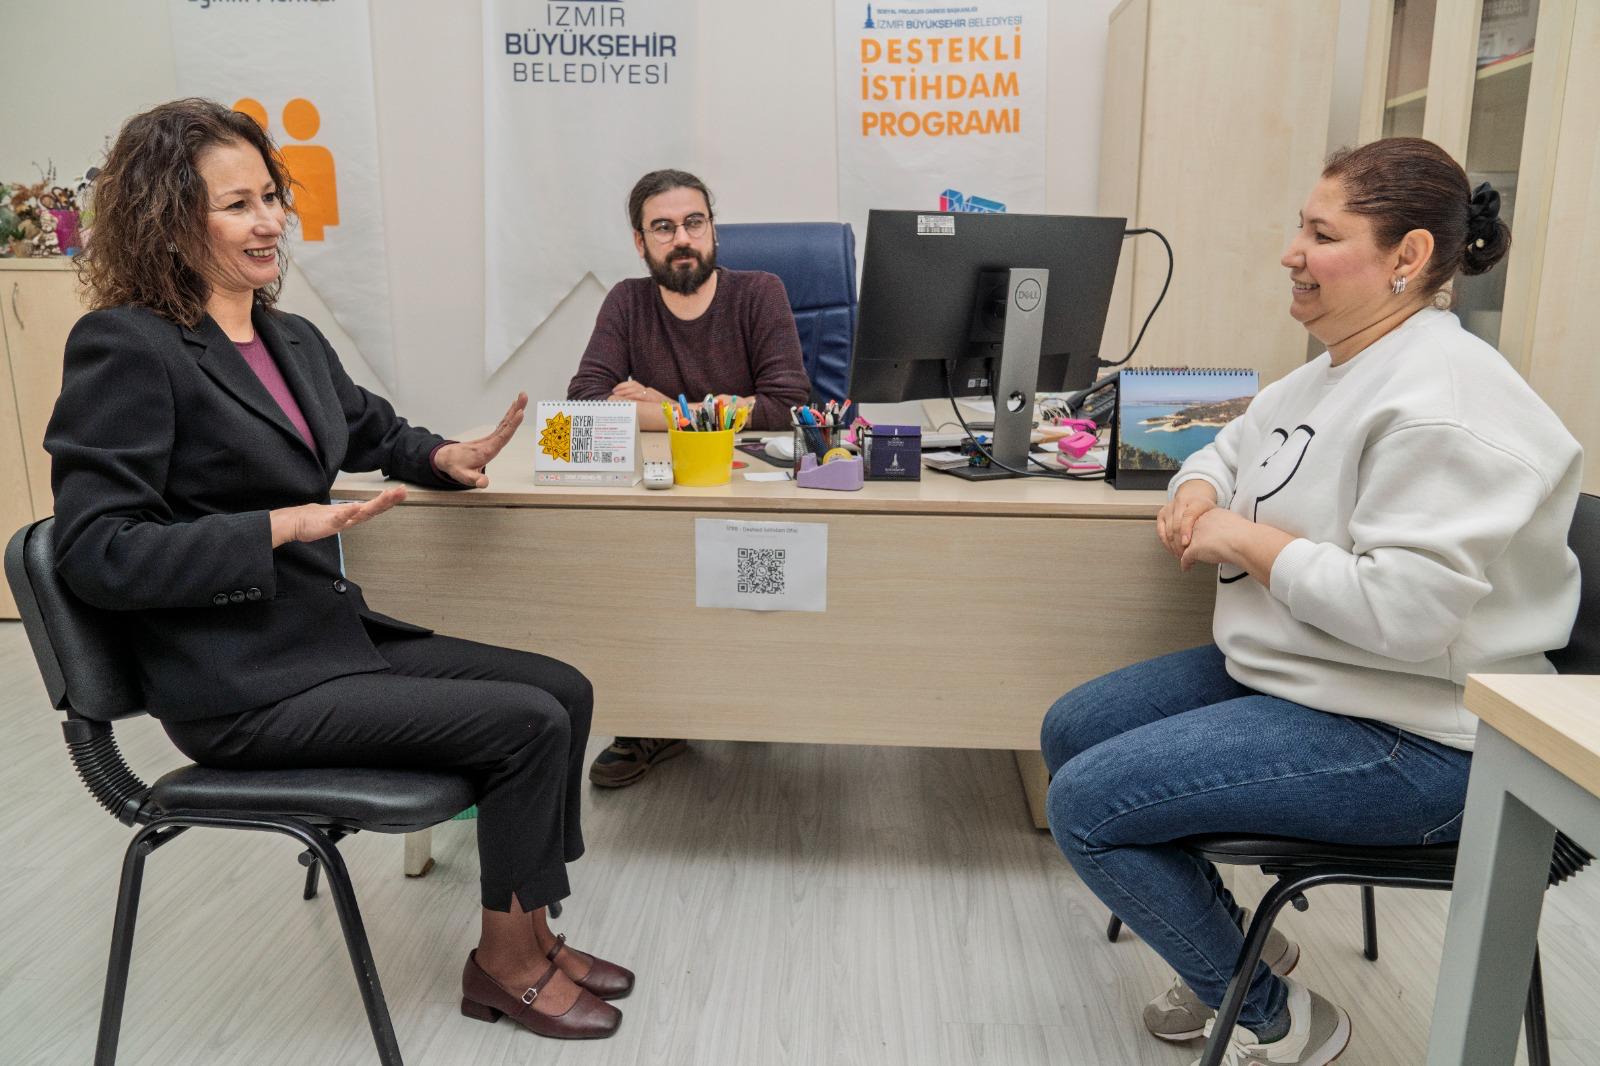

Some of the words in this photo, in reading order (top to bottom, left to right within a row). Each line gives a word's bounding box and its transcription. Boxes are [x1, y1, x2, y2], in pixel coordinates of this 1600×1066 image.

[547, 3, 625, 27] İZMİR
[505, 28, 676, 60] BÜYÜKŞEHİR
[860, 26, 1022, 65] DESTEKLİ
[513, 62, 668, 85] BELEDİYESİ
[861, 67, 1020, 101] İSTİHDAM
[861, 108, 1021, 137] PROGRAMI
[1018, 290, 1038, 299] DELL
